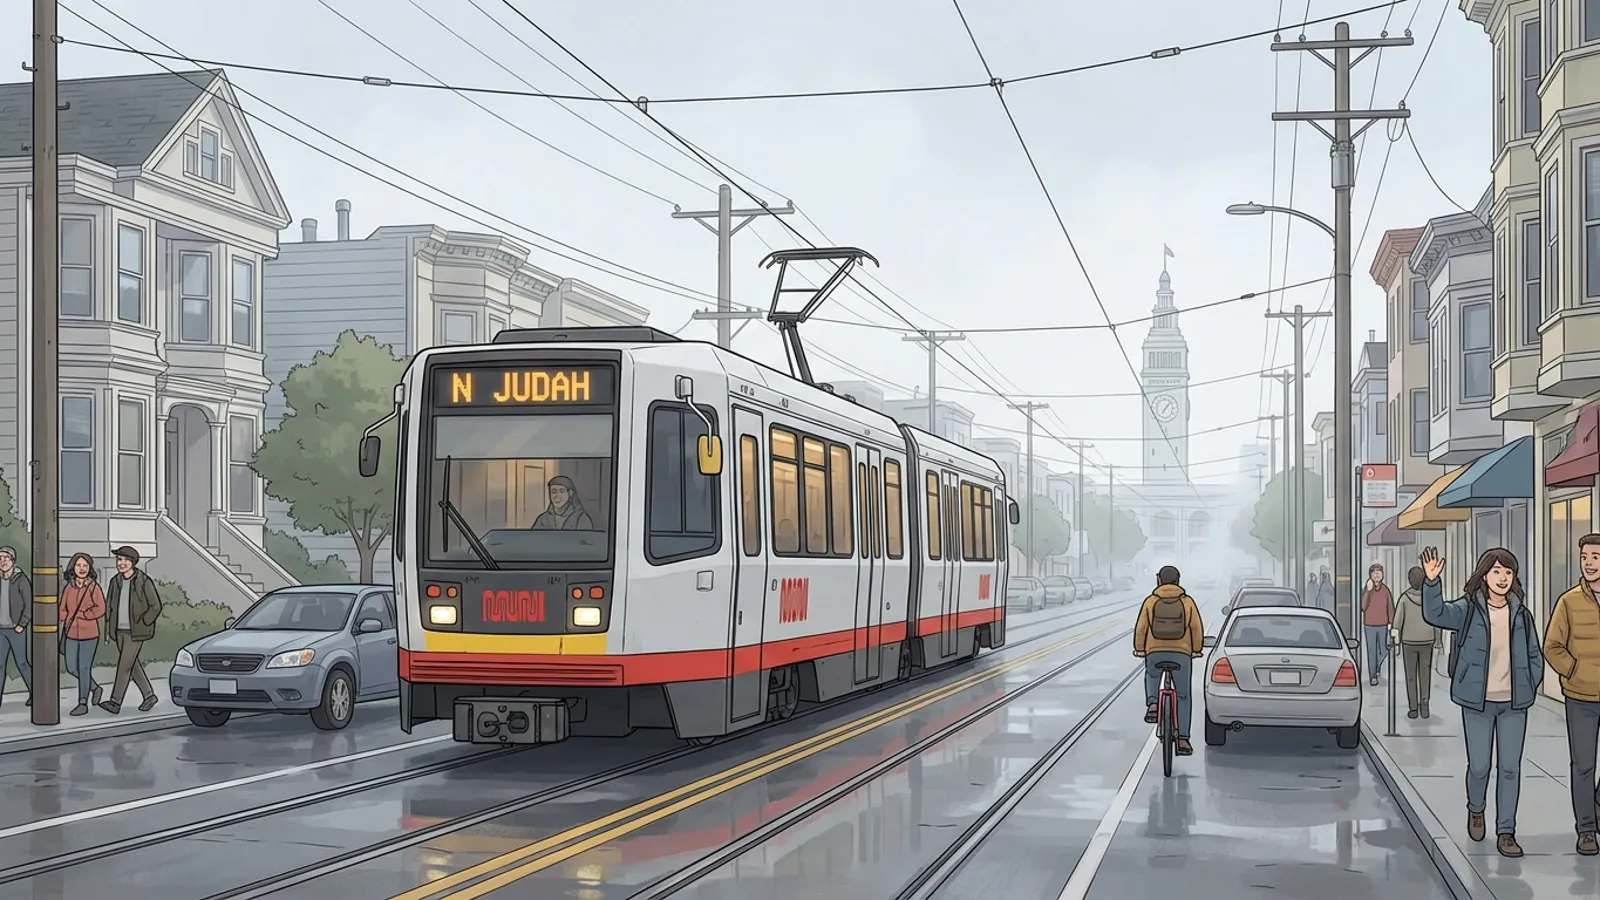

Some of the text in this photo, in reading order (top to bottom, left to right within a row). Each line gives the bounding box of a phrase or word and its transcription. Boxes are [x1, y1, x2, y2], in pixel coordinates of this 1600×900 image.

[451, 371, 591, 403] N JUDAH
[482, 589, 546, 623] MUNI
